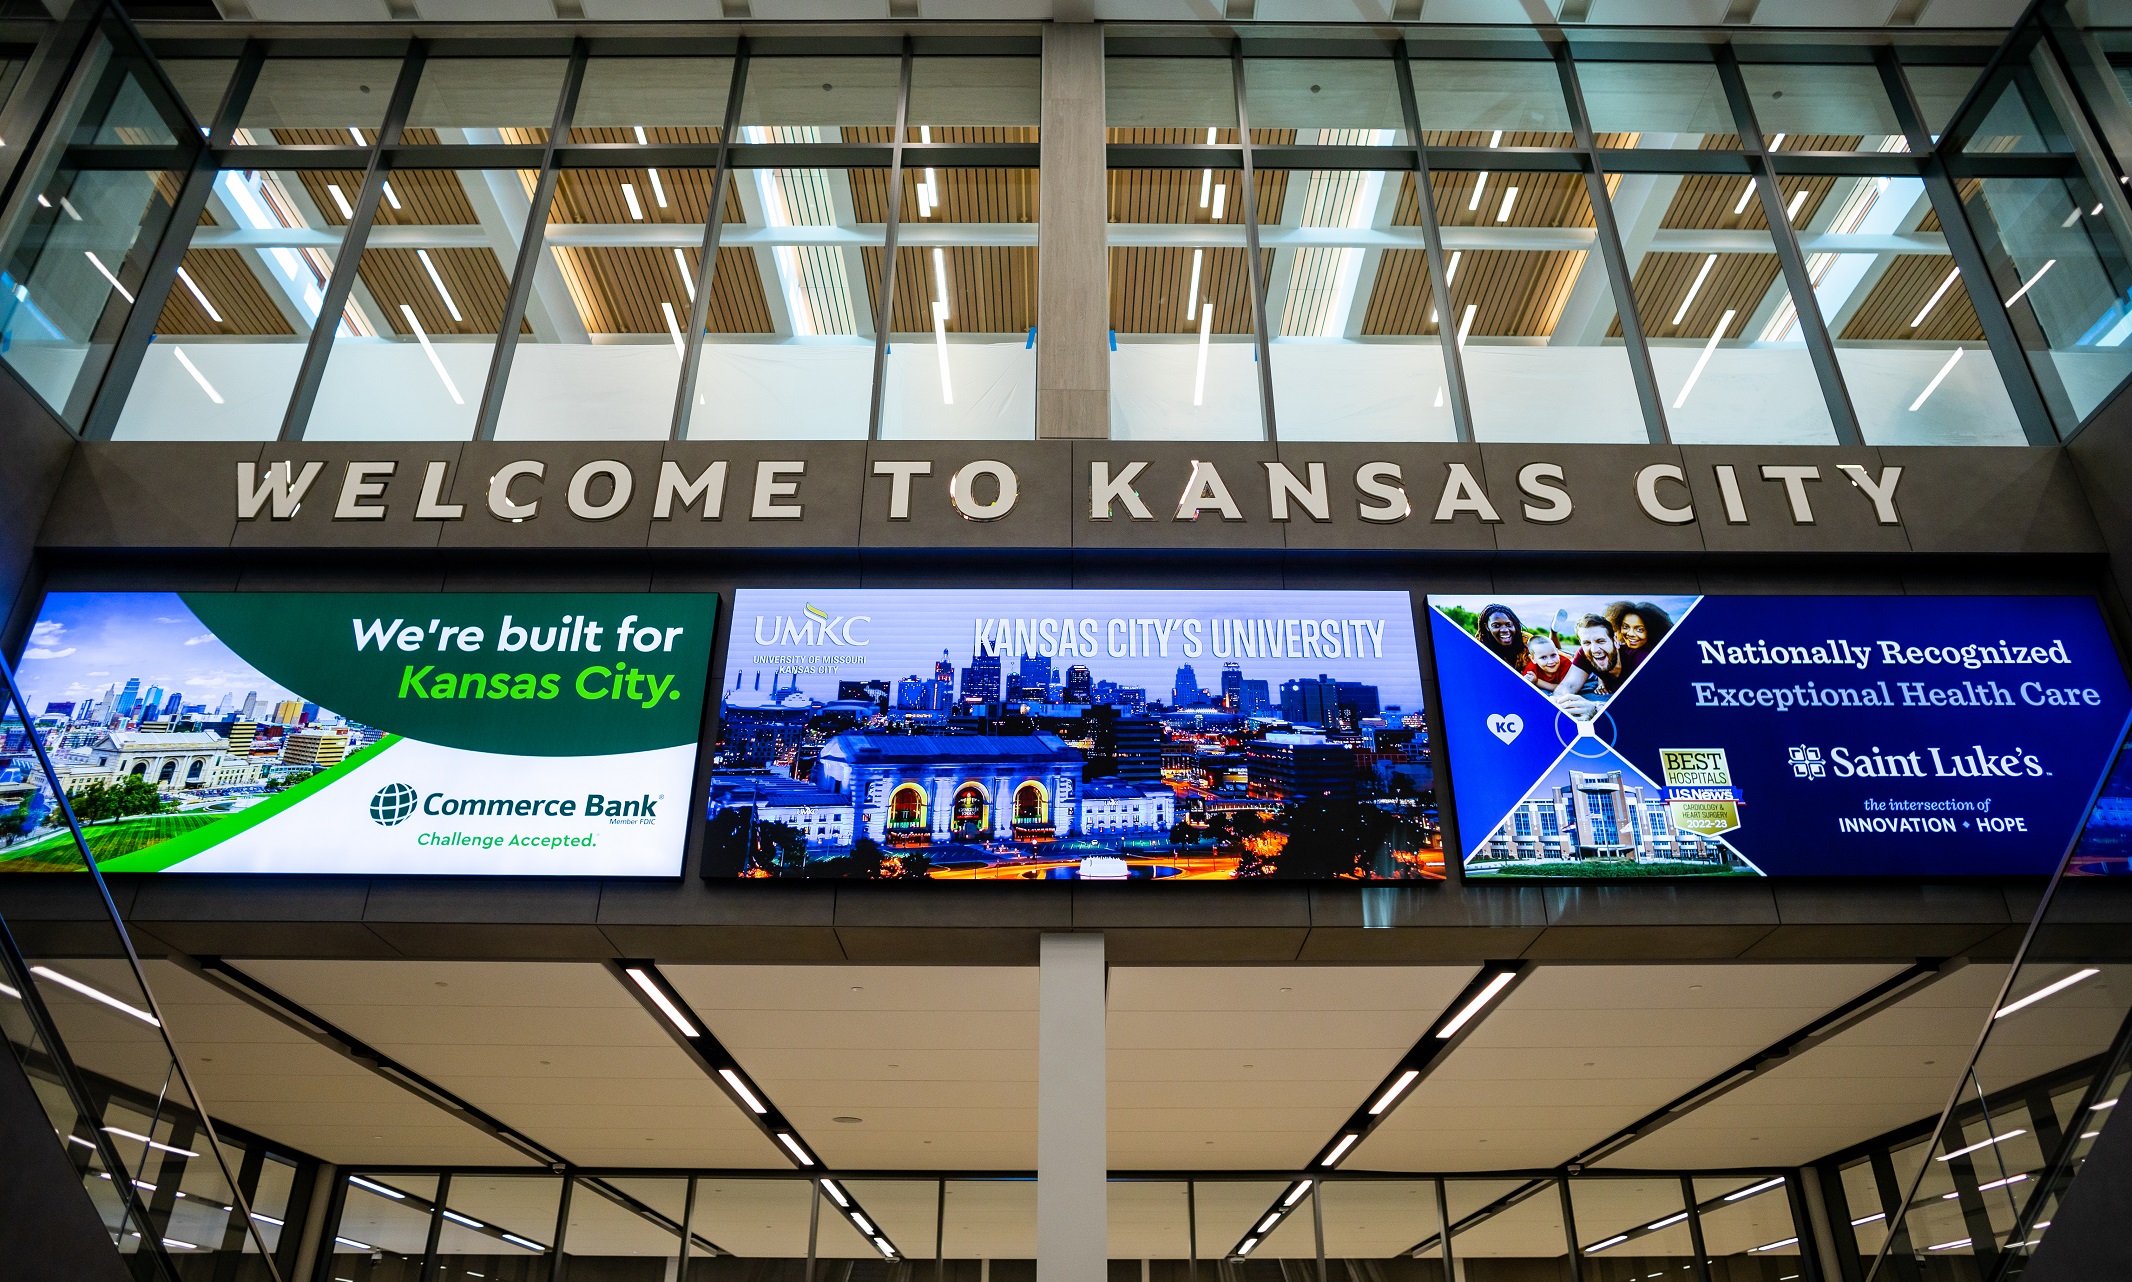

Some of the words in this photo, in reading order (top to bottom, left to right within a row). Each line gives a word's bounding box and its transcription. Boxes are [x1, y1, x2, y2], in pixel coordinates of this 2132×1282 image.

[235, 459, 810, 523] WELCOME
[870, 459, 1021, 523] TO
[1088, 459, 1576, 525] KANSAS
[1633, 463, 1906, 526] CITY
[755, 601, 871, 646] UMKC
[352, 618, 485, 653] We're
[496, 615, 604, 653] built
[616, 615, 684, 653] for
[973, 617, 1099, 659] KANSAS
[1106, 618, 1202, 659] CITY'S
[1210, 618, 1386, 660] UNIVERSITY
[753, 655, 806, 664] UNIVERSITY
[808, 655, 820, 664] OF
[822, 655, 866, 664] MISSOURI
[1697, 639, 1872, 670] Nationally
[1877, 640, 2072, 669] Recognized
[779, 665, 816, 674] KANSAS
[818, 665, 839, 674] CITY
[397, 665, 562, 700] Kansas
[574, 661, 682, 710] City.
[1691, 681, 1895, 712] Exceptional
[1897, 681, 2016, 707] Health
[2019, 681, 2101, 707] Care
[1495, 721, 1517, 734] KC
[1664, 753, 1722, 770] BEST
[1830, 746, 1928, 778] Saint
[1927, 745, 2044, 778] Luke's
[1668, 772, 1727, 785] HOSPITALS
[422, 792, 577, 818] Commerce
[1682, 803, 1718, 811] CARDIOLOGY
[1863, 798, 1887, 811] the
[1888, 798, 1975, 812] intersection
[1977, 798, 1992, 813] of
[1682, 811, 1701, 819] HEART
[1701, 811, 1728, 819] SURGERY
[1686, 819, 1728, 829] 2022-23
[1838, 817, 1957, 833] INNOVATION
[1975, 817, 2028, 832] HOPE
[417, 832, 504, 850] Challenge
[508, 833, 597, 850] Accepted.
